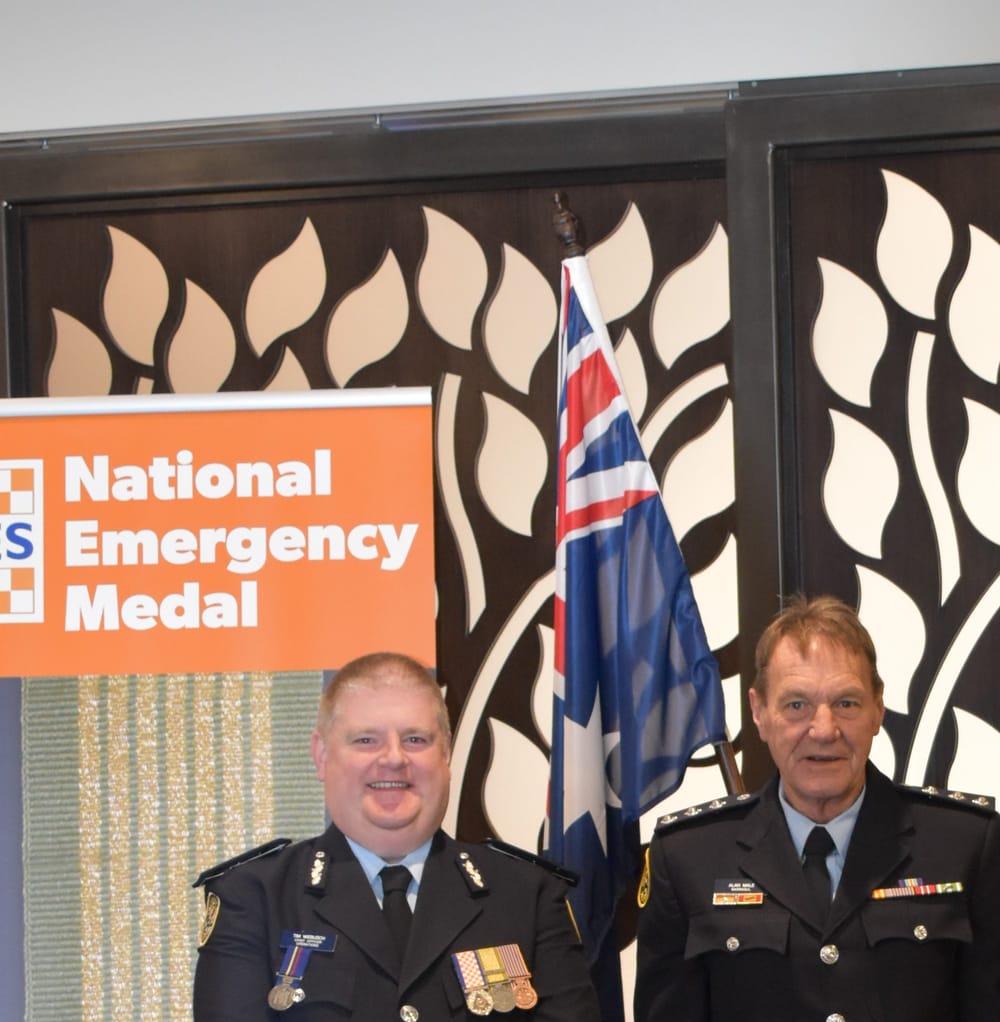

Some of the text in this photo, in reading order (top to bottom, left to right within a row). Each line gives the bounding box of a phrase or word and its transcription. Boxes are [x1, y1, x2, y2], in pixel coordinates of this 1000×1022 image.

[65, 449, 331, 502] National
[65, 519, 419, 574] Emergency
[65, 580, 258, 632] Medal
